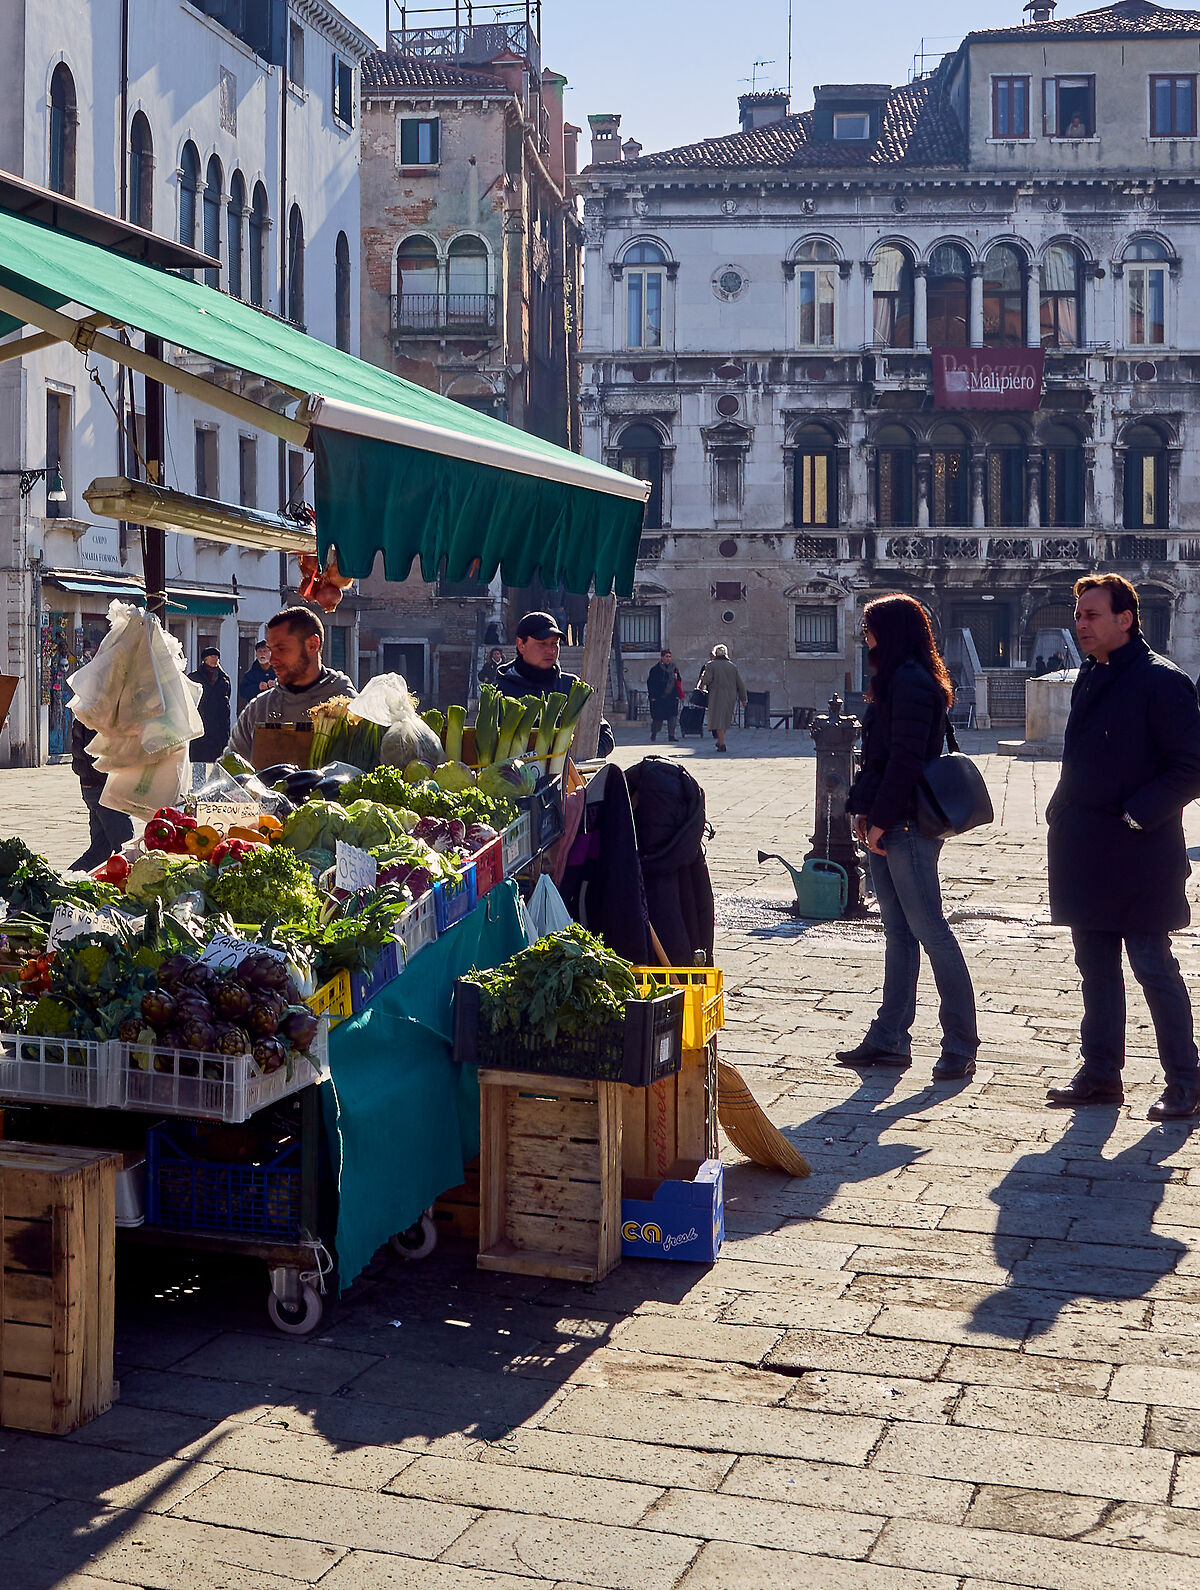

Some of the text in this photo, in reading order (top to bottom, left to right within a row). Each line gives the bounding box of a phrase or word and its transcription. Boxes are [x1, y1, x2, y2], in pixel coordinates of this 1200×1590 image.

[970, 371, 1035, 394] Malipiero
[196, 803, 240, 815] PEPERONI
[55, 907, 99, 925] MARINDA
[662, 1227, 699, 1252] fresh
